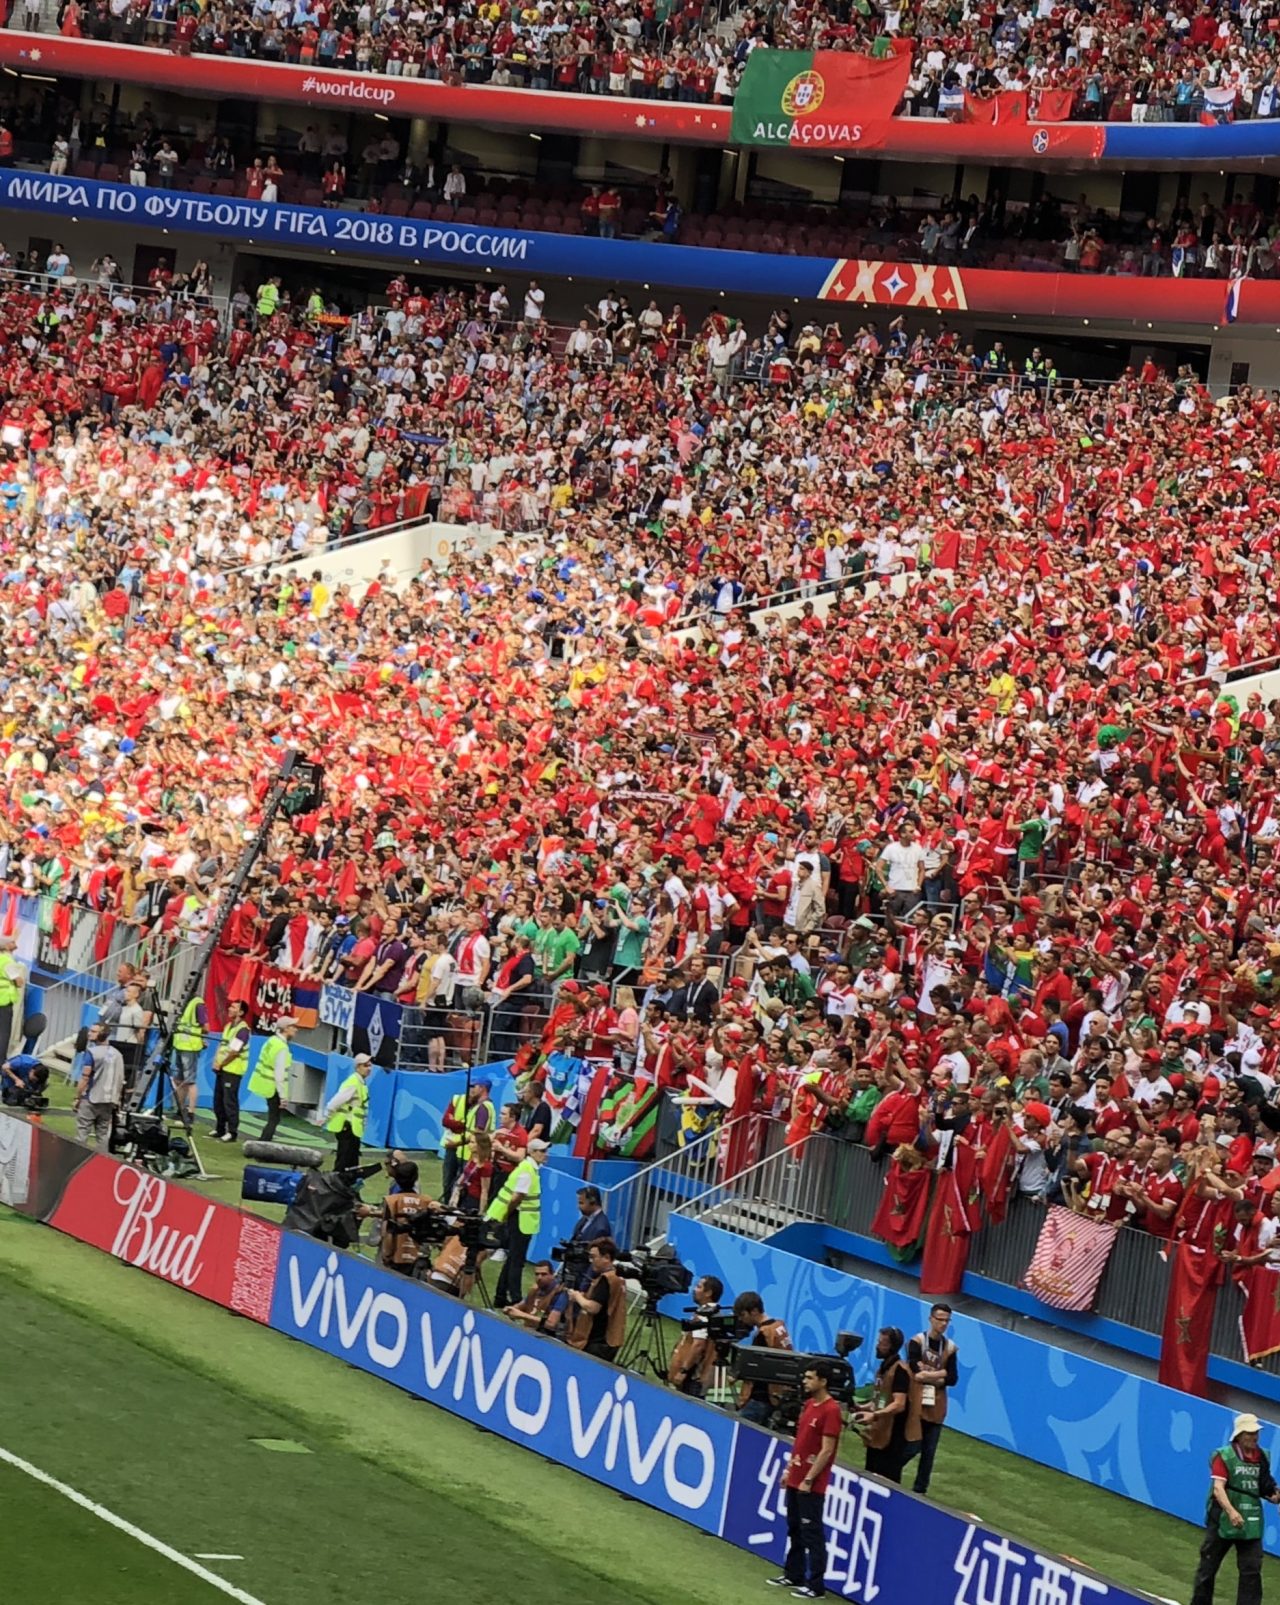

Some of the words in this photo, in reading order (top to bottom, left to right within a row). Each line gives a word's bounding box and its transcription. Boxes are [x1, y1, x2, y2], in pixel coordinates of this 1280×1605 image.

[302, 76, 395, 104] #worldcup
[753, 120, 862, 143] ALCÁÇOVAS
[8, 177, 89, 207] МИРА
[96, 187, 137, 213] ПО
[144, 194, 268, 228] ФУТБОЛУ
[274, 210, 328, 238] FIFA
[336, 218, 393, 245] 2018
[400, 225, 417, 247] В
[423, 228, 526, 260] РОССИИ
[113, 1165, 216, 1286] Bud
